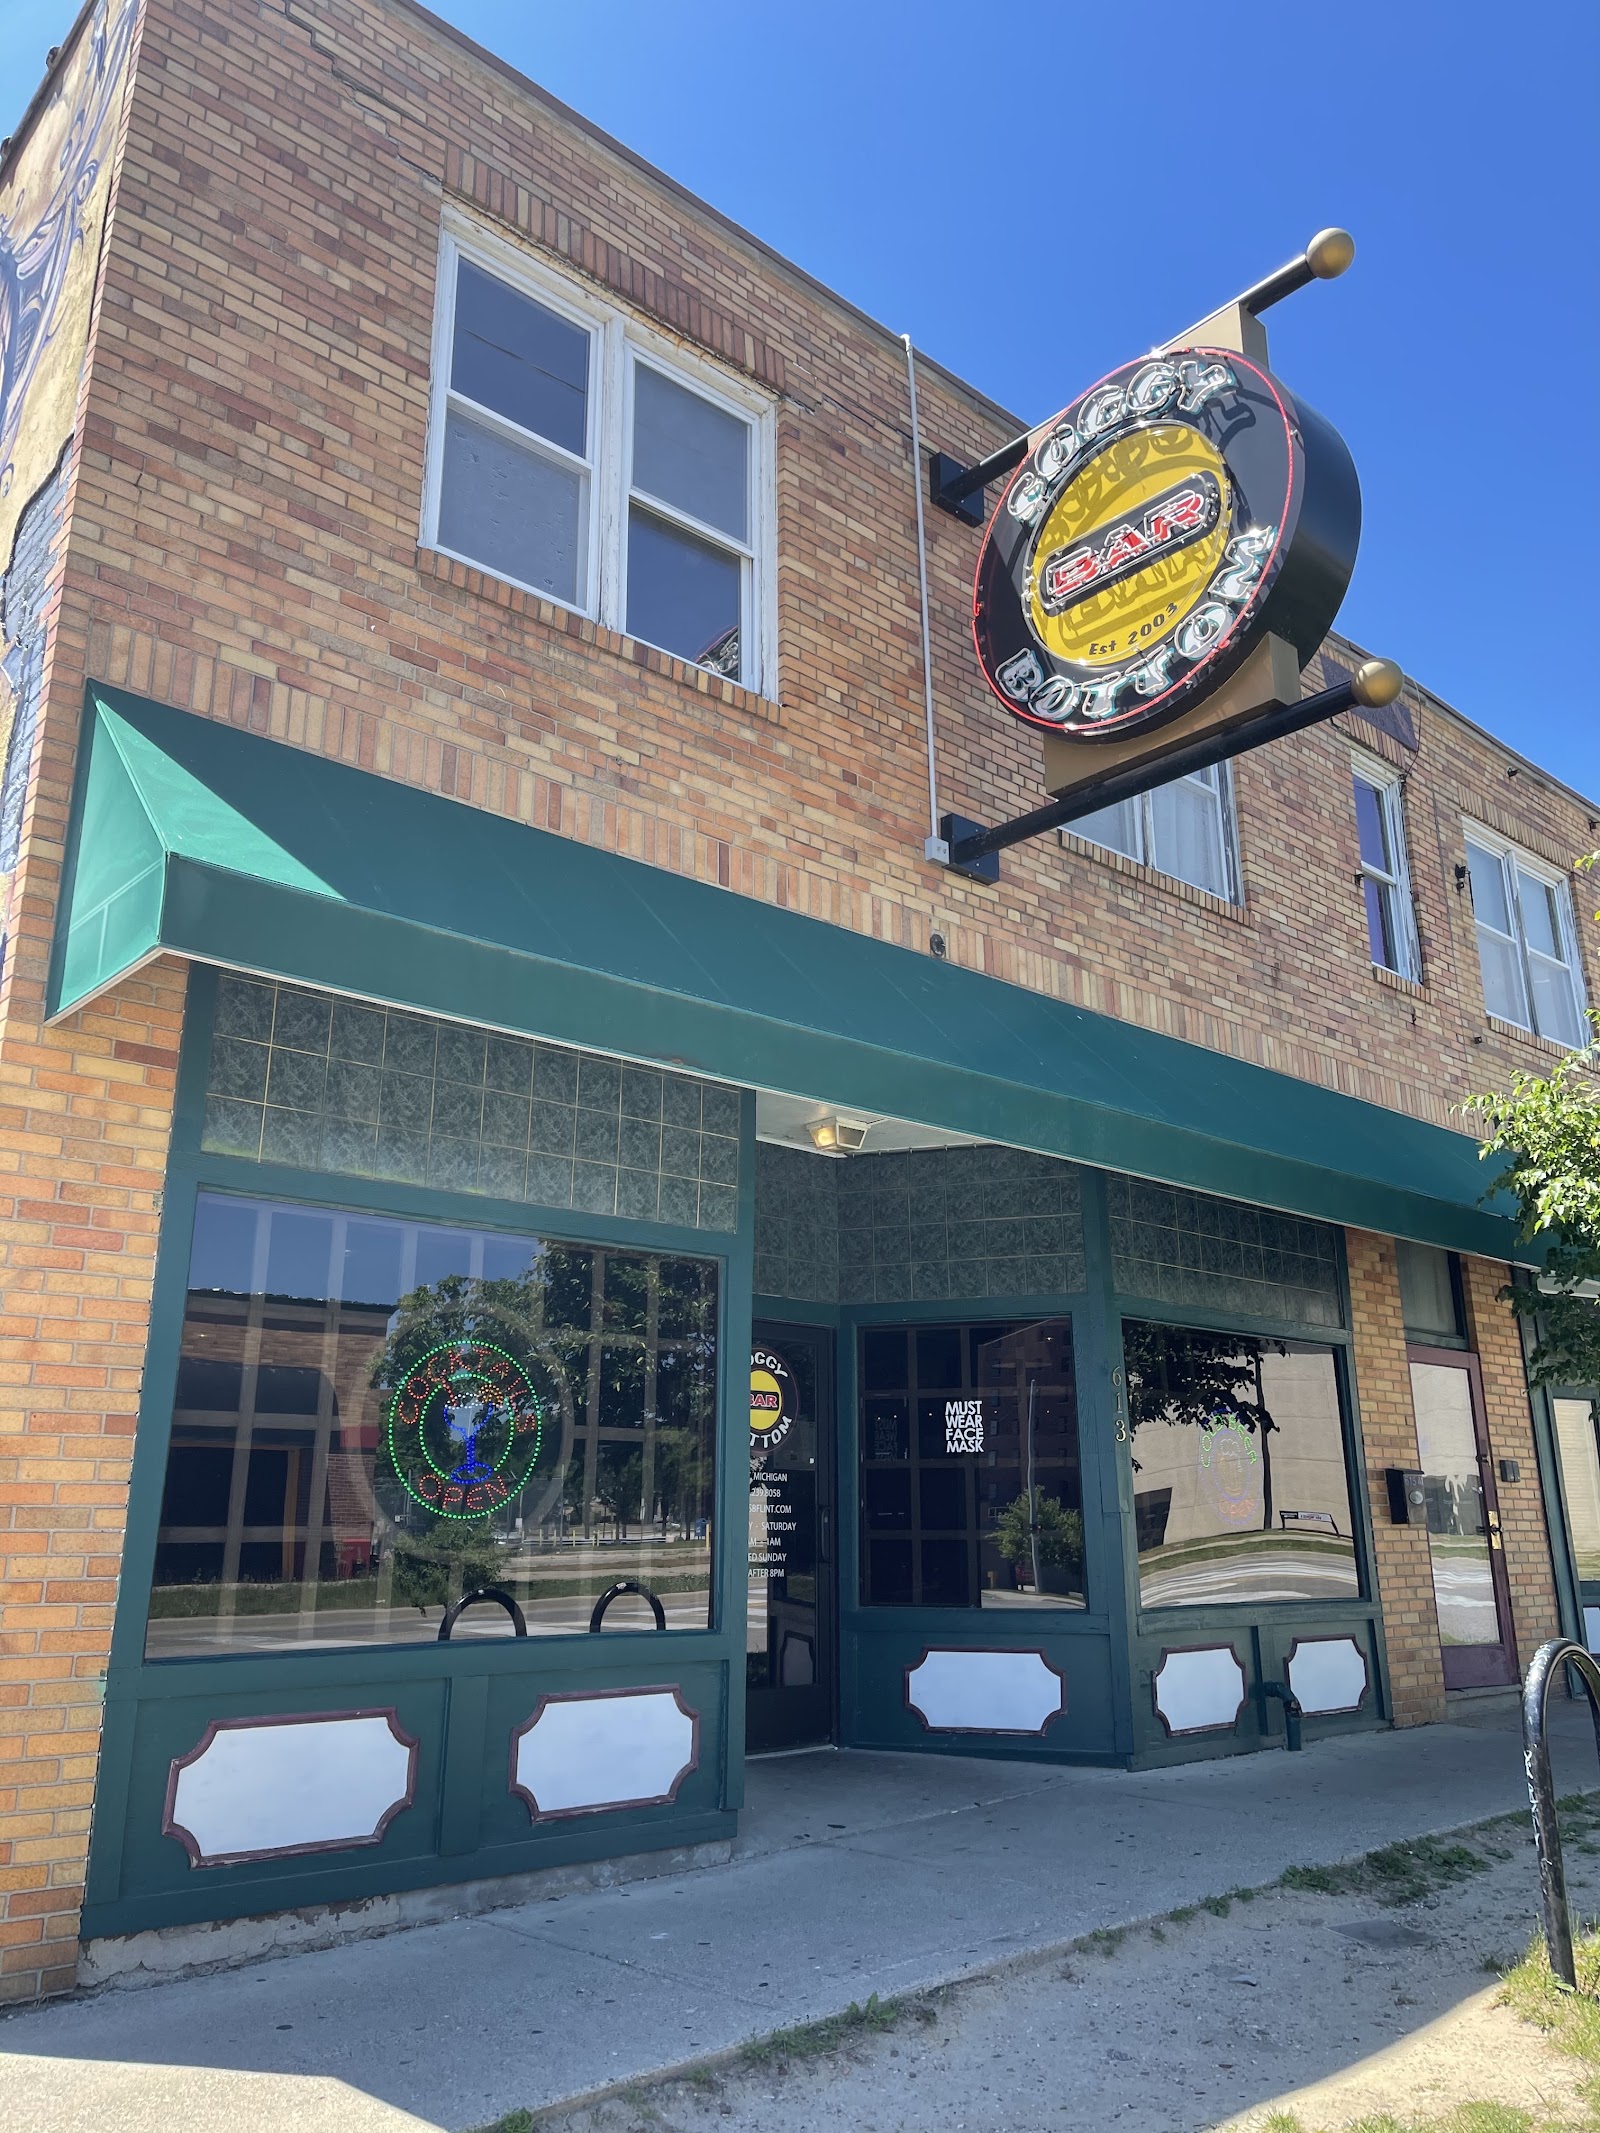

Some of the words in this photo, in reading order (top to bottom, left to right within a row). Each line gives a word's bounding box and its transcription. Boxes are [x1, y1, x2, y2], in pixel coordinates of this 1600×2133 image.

[1007, 360, 1236, 527] SOGGY
[1046, 489, 1205, 600] BAR
[995, 525, 1278, 720] BOTTOM
[1089, 640, 1117, 655] Est
[1128, 602, 1178, 644] 2003
[399, 1348, 535, 1433] COCKTAILS
[945, 1400, 982, 1416] MUST
[945, 1414, 983, 1428] WEAR
[945, 1427, 984, 1441] FACE
[946, 1440, 985, 1453] MASK
[753, 1471, 788, 1482] MICHIGAN
[419, 1474, 508, 1509] OPEN
[761, 1521, 797, 1531] SATURDAY
[758, 1552, 788, 1562] SUNDAY
[747, 1568, 769, 1578] AFTER
[769, 1568, 785, 1578] 8PM
